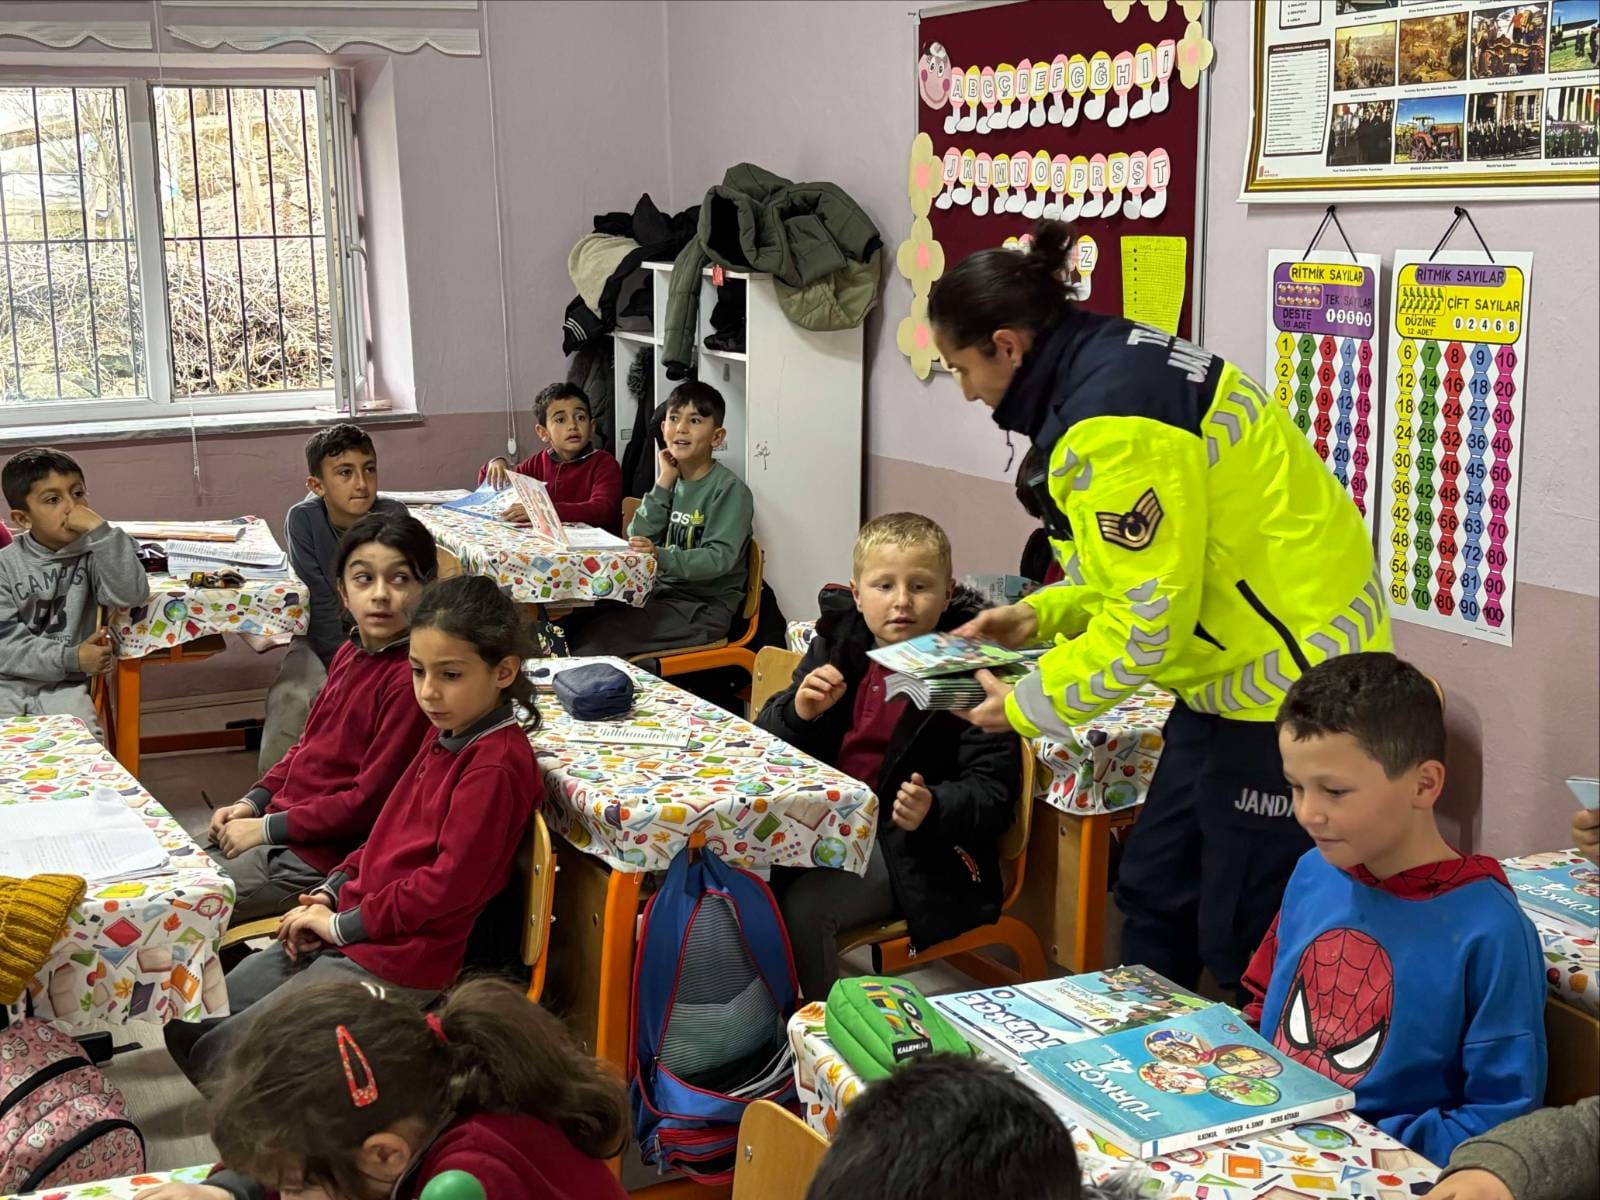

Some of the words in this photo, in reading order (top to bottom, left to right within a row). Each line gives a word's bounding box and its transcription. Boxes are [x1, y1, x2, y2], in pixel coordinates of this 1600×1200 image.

[953, 79, 962, 98] A
[968, 79, 978, 97] B
[983, 80, 992, 98] C
[998, 76, 1010, 97] Ç
[1019, 74, 1028, 94] D
[1035, 71, 1046, 91] E
[1052, 66, 1063, 88] F
[1071, 67, 1084, 88] G
[1095, 62, 1107, 85] Ğ
[1116, 64, 1130, 86] H
[947, 159, 955, 178] J
[964, 160, 972, 179] K
[978, 163, 987, 183] L
[995, 163, 1006, 184] M
[1014, 162, 1026, 182] N
[1035, 162, 1046, 182] O
[1053, 166, 1064, 187] Ö
[1073, 169, 1084, 188] P
[1092, 166, 1103, 186] R
[1112, 162, 1123, 183] S
[1132, 161, 1144, 185] Ş
[1154, 160, 1166, 183] T
[1081, 246, 1092, 267] Z
[1291, 266, 1324, 279] RİTMİK
[1330, 270, 1362, 282] SAYILAR
[1417, 266, 1451, 281] RİTMİK
[1457, 271, 1504, 283] SAYILAR
[1326, 295, 1340, 305] TEK
[1447, 296, 1469, 312] ÇİFT
[1475, 299, 1520, 312] SAYILAR
[1283, 309, 1312, 320] DESTE
[1293, 321, 1311, 329] ADET
[1405, 314, 1436, 327] DÜZİNE
[1456, 318, 1460, 328] 0
[1468, 319, 1474, 329] 2
[1482, 320, 1488, 330] 4
[1496, 321, 1501, 330] 6
[1509, 321, 1514, 331] 8
[1282, 338, 1288, 350] 1
[1303, 339, 1310, 353] 2
[1325, 342, 1331, 355] 3
[1344, 344, 1351, 357] 4
[1362, 347, 1368, 360] 5
[1404, 345, 1411, 359] 6
[1428, 347, 1435, 361] 7
[1451, 349, 1459, 363] 8
[1476, 350, 1484, 365] 9
[1498, 352, 1515, 368] 10
[1281, 364, 1288, 377] 2
[1301, 366, 1308, 380] 4
[1323, 369, 1330, 382] 6
[1343, 371, 1350, 385] 8
[1359, 374, 1371, 387] 10
[1398, 374, 1413, 388] 12
[1422, 375, 1438, 390] 14
[1447, 378, 1464, 393] 16
[1471, 380, 1488, 395] 18
[1496, 382, 1513, 397] 20
[1280, 388, 1287, 401] 3
[1300, 390, 1307, 403] 6
[1321, 393, 1328, 406] 9
[1340, 395, 1352, 410] 12
[1358, 399, 1370, 414] 15
[1398, 399, 1413, 414] 18
[1421, 401, 1436, 416] 21
[1444, 404, 1461, 419] 24
[1469, 406, 1487, 422] 27
[1495, 408, 1512, 425] 30
[1298, 414, 1305, 429] 8
[1316, 418, 1330, 433] 12
[1337, 422, 1350, 436] 16
[1356, 425, 1369, 439] 20
[1397, 425, 1412, 440] 24
[1419, 428, 1435, 443] 28
[1443, 431, 1461, 446] 32
[1468, 434, 1486, 450] 36
[1493, 436, 1510, 453] 40
[1335, 448, 1348, 463] 20
[1354, 451, 1367, 466] 25
[1395, 453, 1410, 468] 30
[1418, 456, 1434, 471] 35
[1442, 459, 1459, 475] 40
[1467, 462, 1484, 478] 45
[1492, 466, 1509, 482] 50
[1352, 477, 1366, 492] 30
[1395, 480, 1410, 494] 36
[1416, 484, 1433, 499] 42
[1440, 487, 1457, 502] 48
[1466, 491, 1482, 506] 54
[1491, 494, 1507, 511] 60
[1393, 507, 1409, 521] 42
[1416, 511, 1432, 526] 49
[1440, 514, 1457, 530] 56
[1465, 518, 1482, 534] 63
[1490, 522, 1505, 539] 70
[1393, 532, 1409, 547] 48
[1415, 536, 1432, 551] 56
[1439, 540, 1455, 556] 64
[1464, 545, 1479, 561] 72
[1488, 549, 1504, 566] 80
[1392, 559, 1408, 574] 54
[1414, 564, 1430, 579] 63
[1439, 569, 1453, 584] 72
[1461, 573, 1477, 589] 81
[1486, 578, 1502, 595] 90
[1391, 584, 1406, 599] 60
[1415, 590, 1429, 605] 70
[1438, 595, 1451, 610] 80
[1461, 599, 1477, 616] 90
[1484, 606, 1504, 622] 100
[1098, 1058, 1135, 1074] 4
[1064, 1058, 1162, 1122] TÜRKÇE
[1270, 1115, 1283, 1124] DERS
